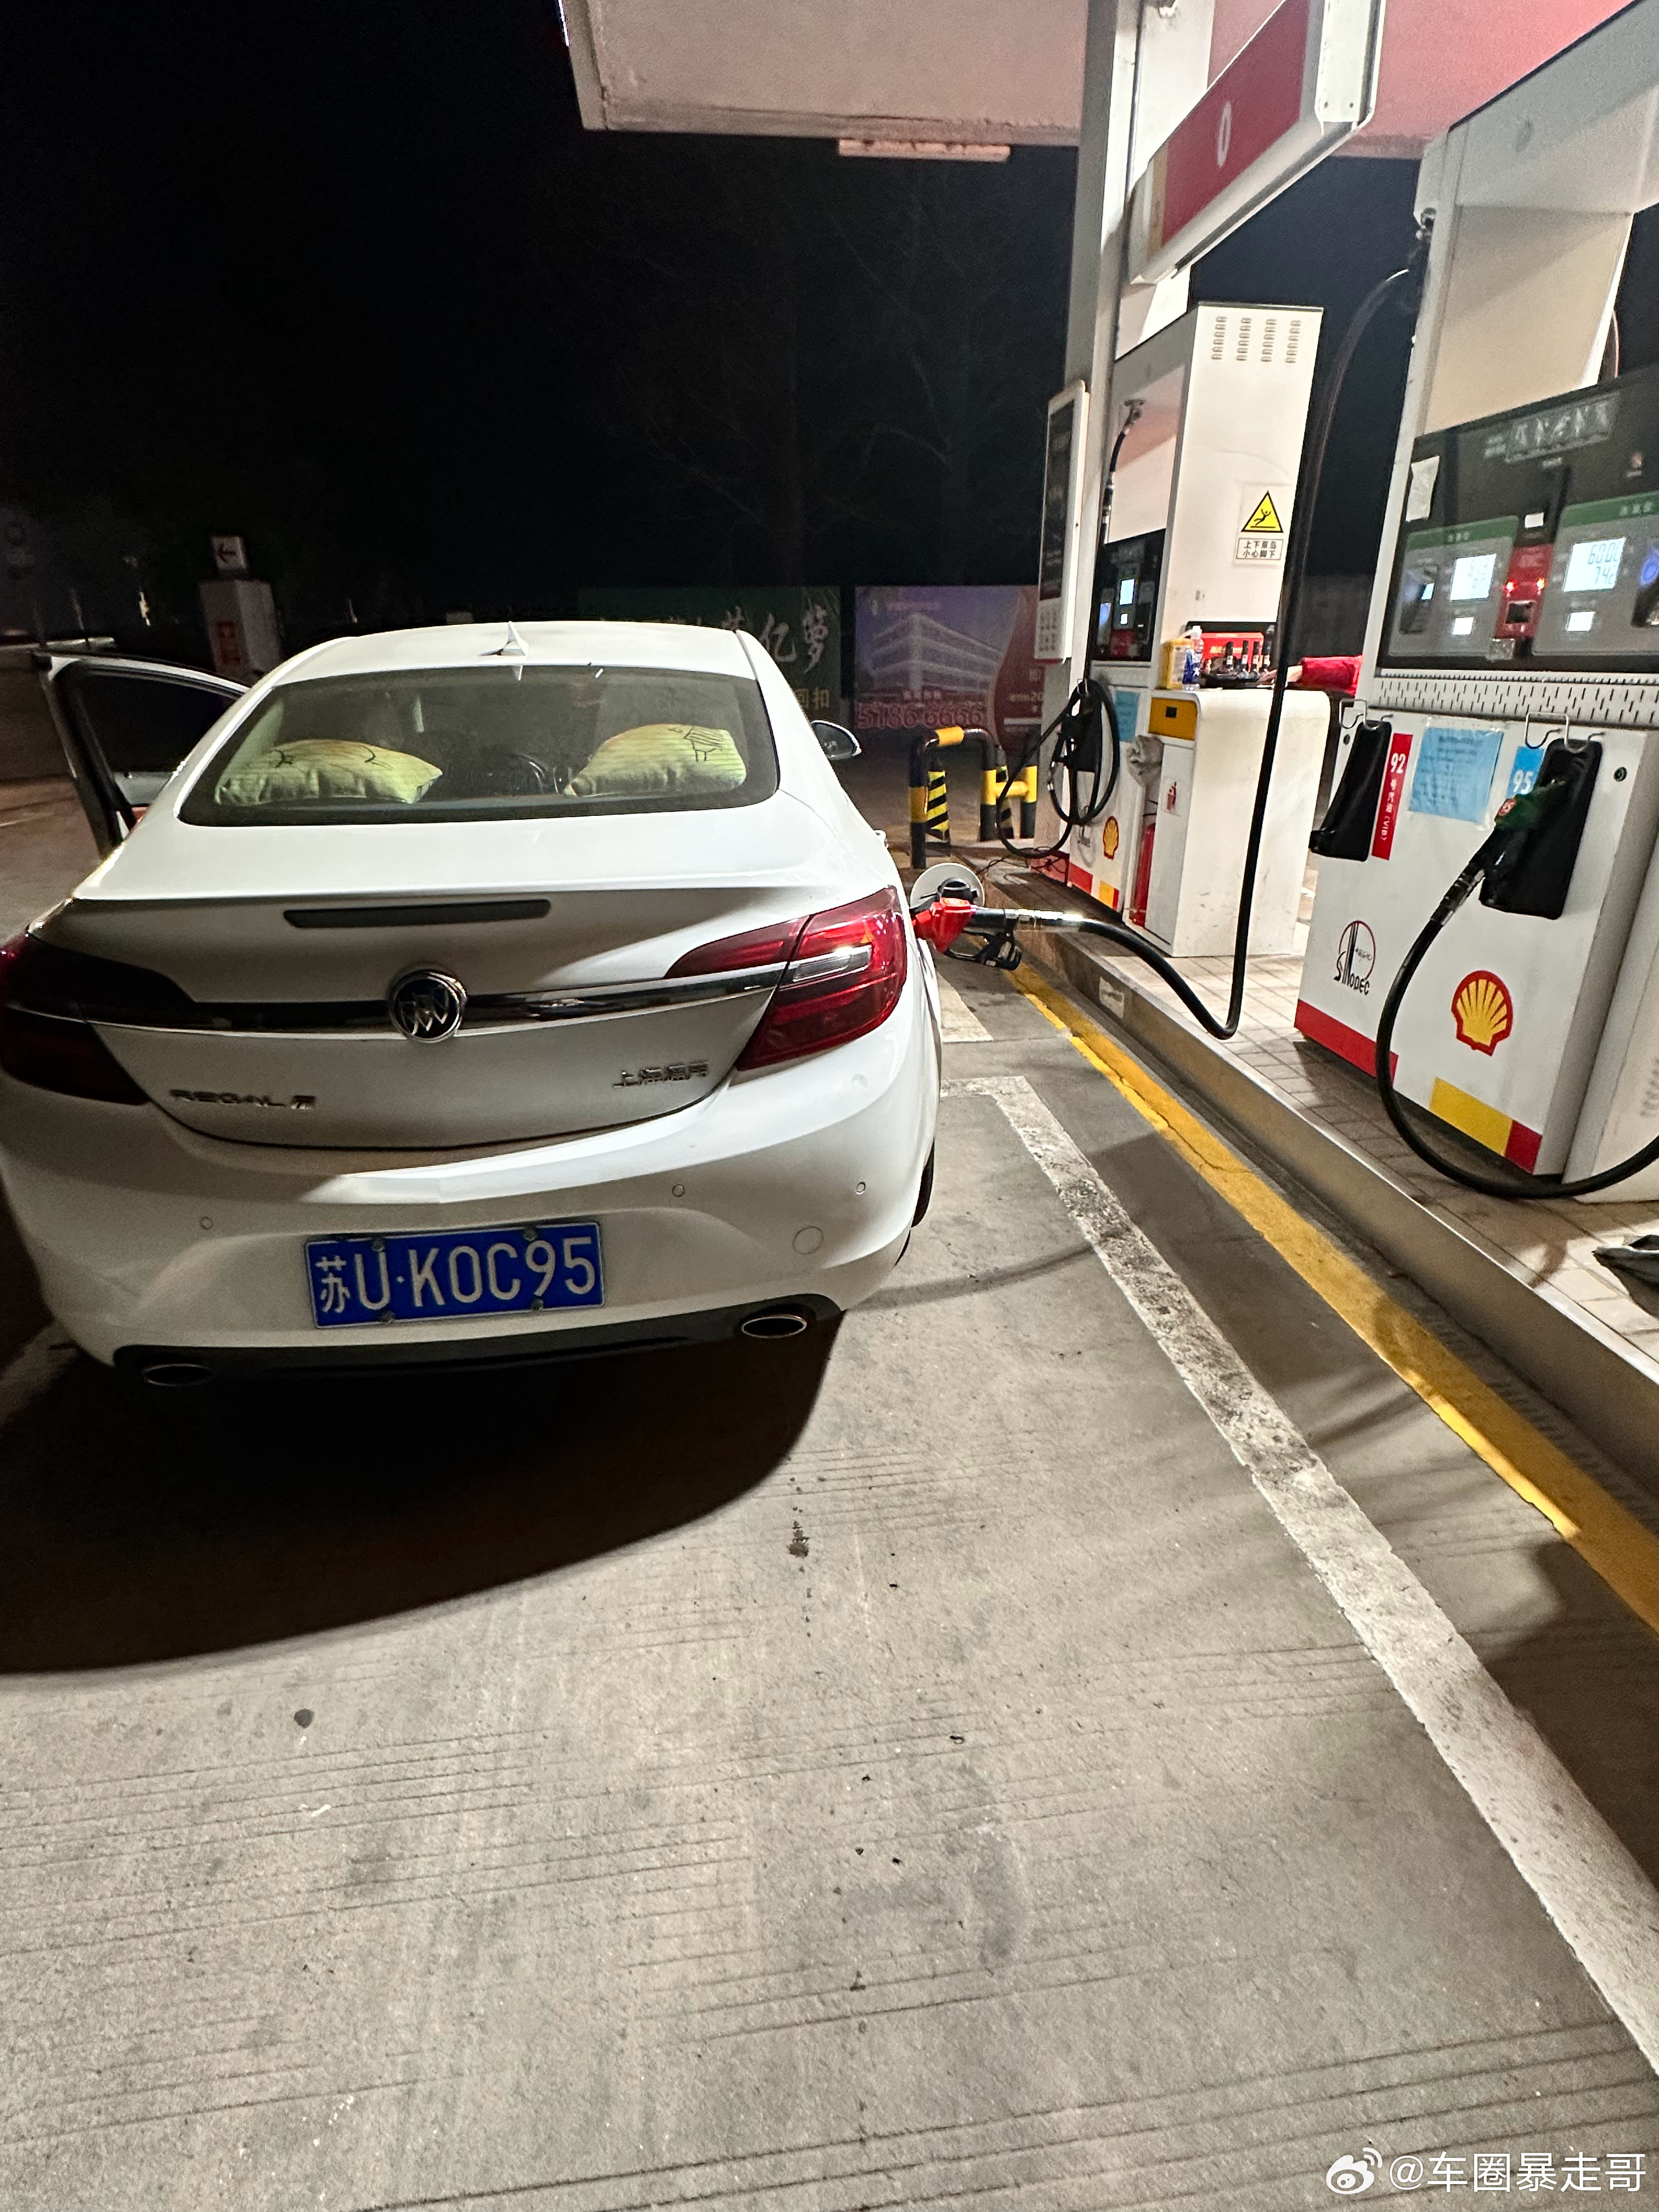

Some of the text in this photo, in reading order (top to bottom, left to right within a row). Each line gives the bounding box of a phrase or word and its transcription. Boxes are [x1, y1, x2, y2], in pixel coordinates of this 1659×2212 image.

[1390, 752, 1407, 774] 92
[1513, 769, 1534, 795] 95
[169, 1088, 286, 1107] REGAL
